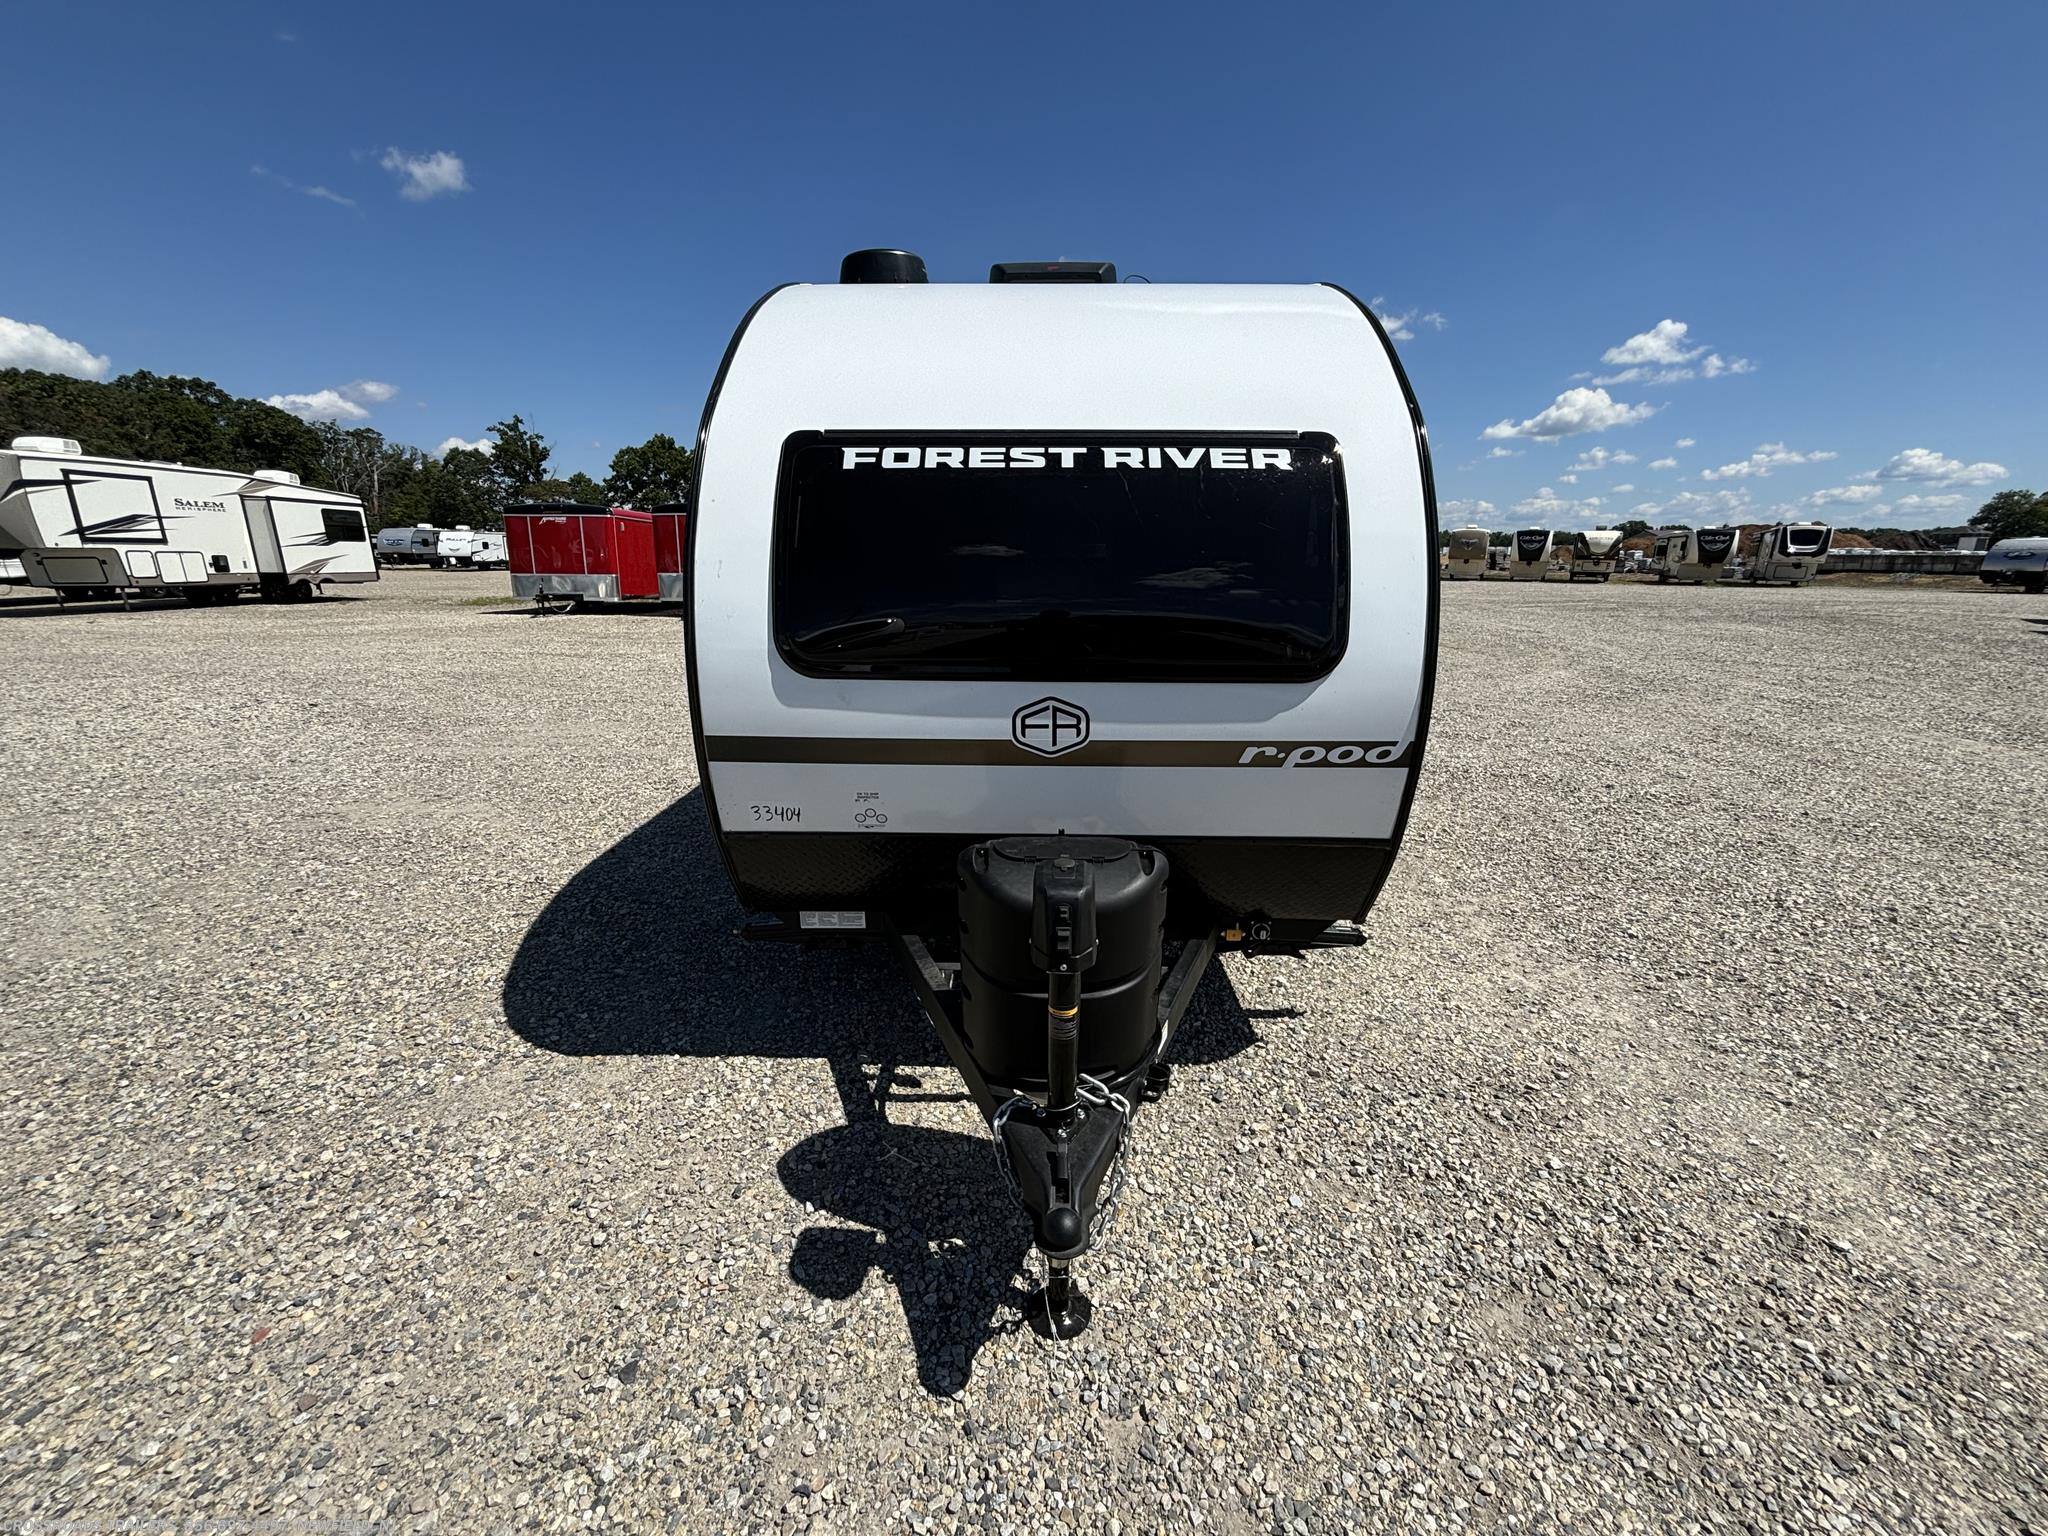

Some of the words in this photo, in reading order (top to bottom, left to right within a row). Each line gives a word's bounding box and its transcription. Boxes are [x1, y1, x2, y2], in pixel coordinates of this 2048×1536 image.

[841, 447, 1088, 470] FOREST
[1101, 447, 1294, 471] RIVER
[174, 498, 225, 509] SALEM
[750, 805, 801, 823] 33404
